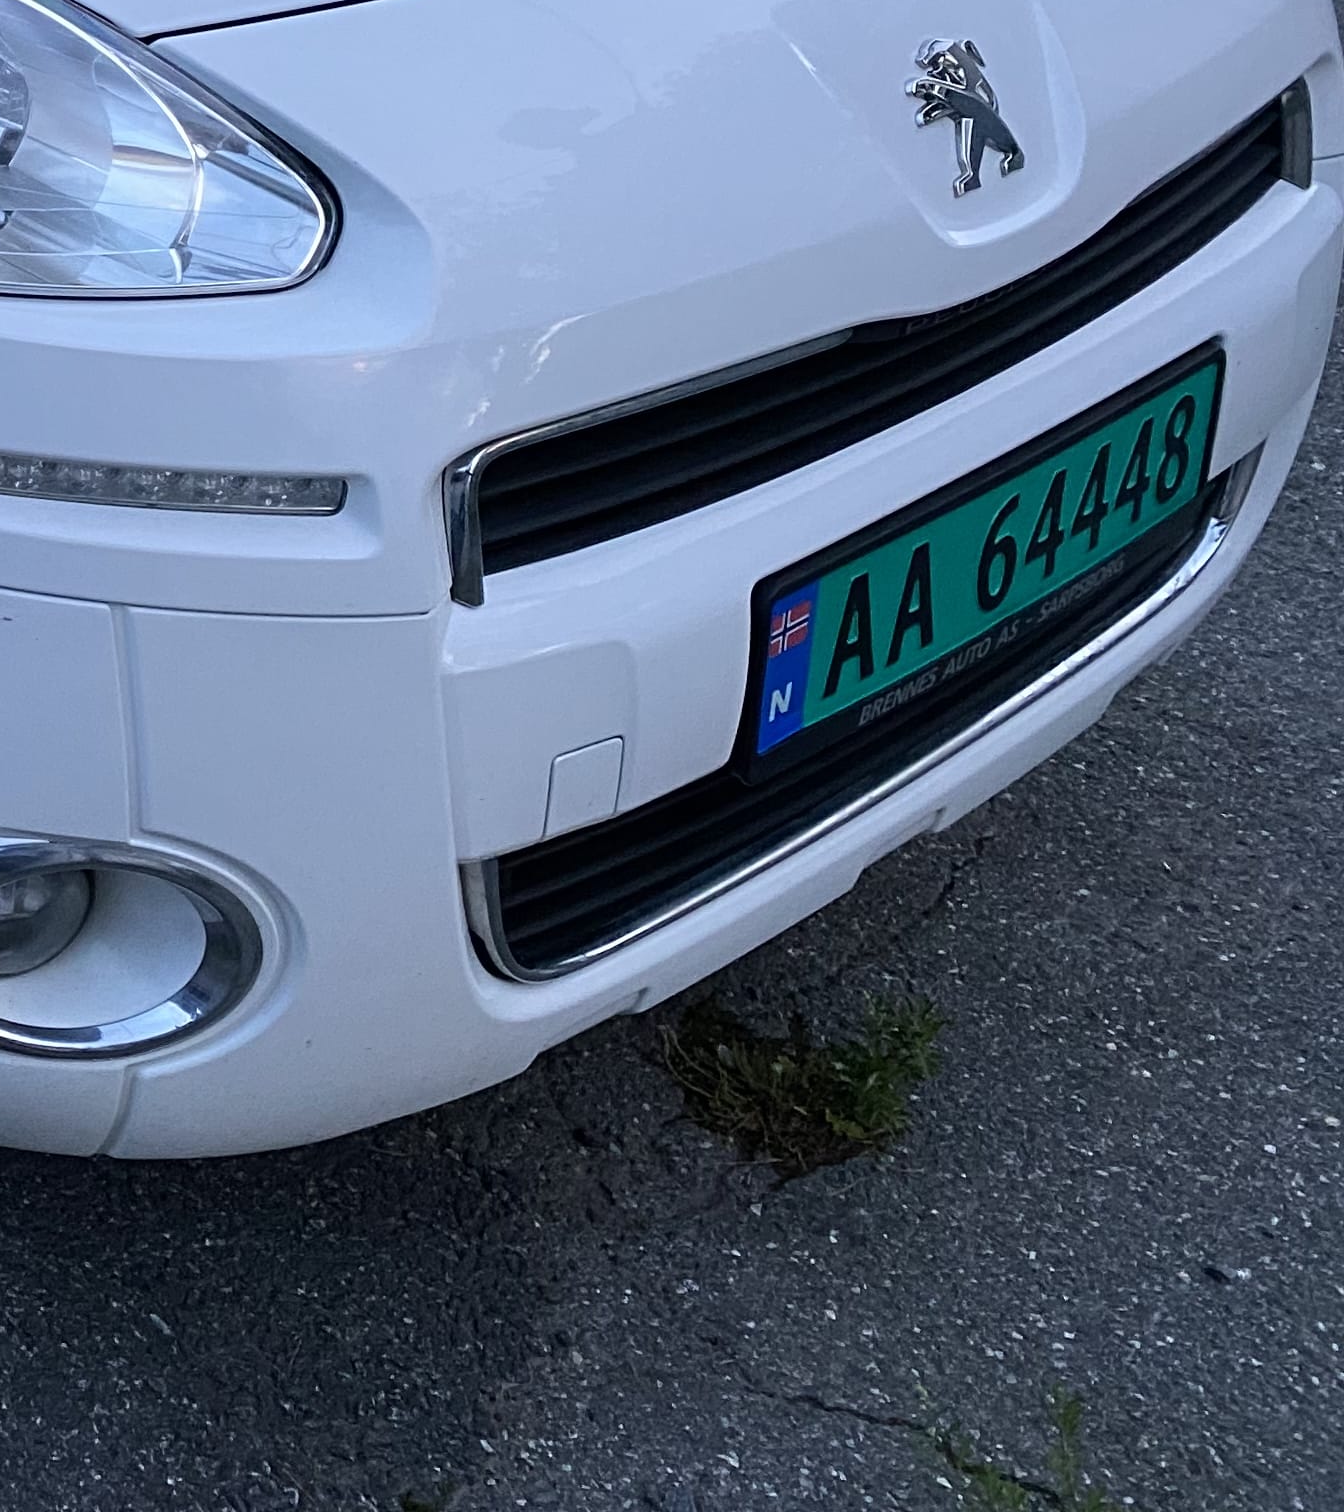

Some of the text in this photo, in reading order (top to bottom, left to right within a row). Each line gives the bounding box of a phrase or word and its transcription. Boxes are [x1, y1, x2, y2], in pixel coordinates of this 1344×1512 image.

[822, 393, 1196, 698] AA 64448
[768, 681, 793, 722] N
[859, 665, 940, 727] BRENNES
[942, 637, 992, 681] AUTO
[995, 622, 1019, 651] AS
